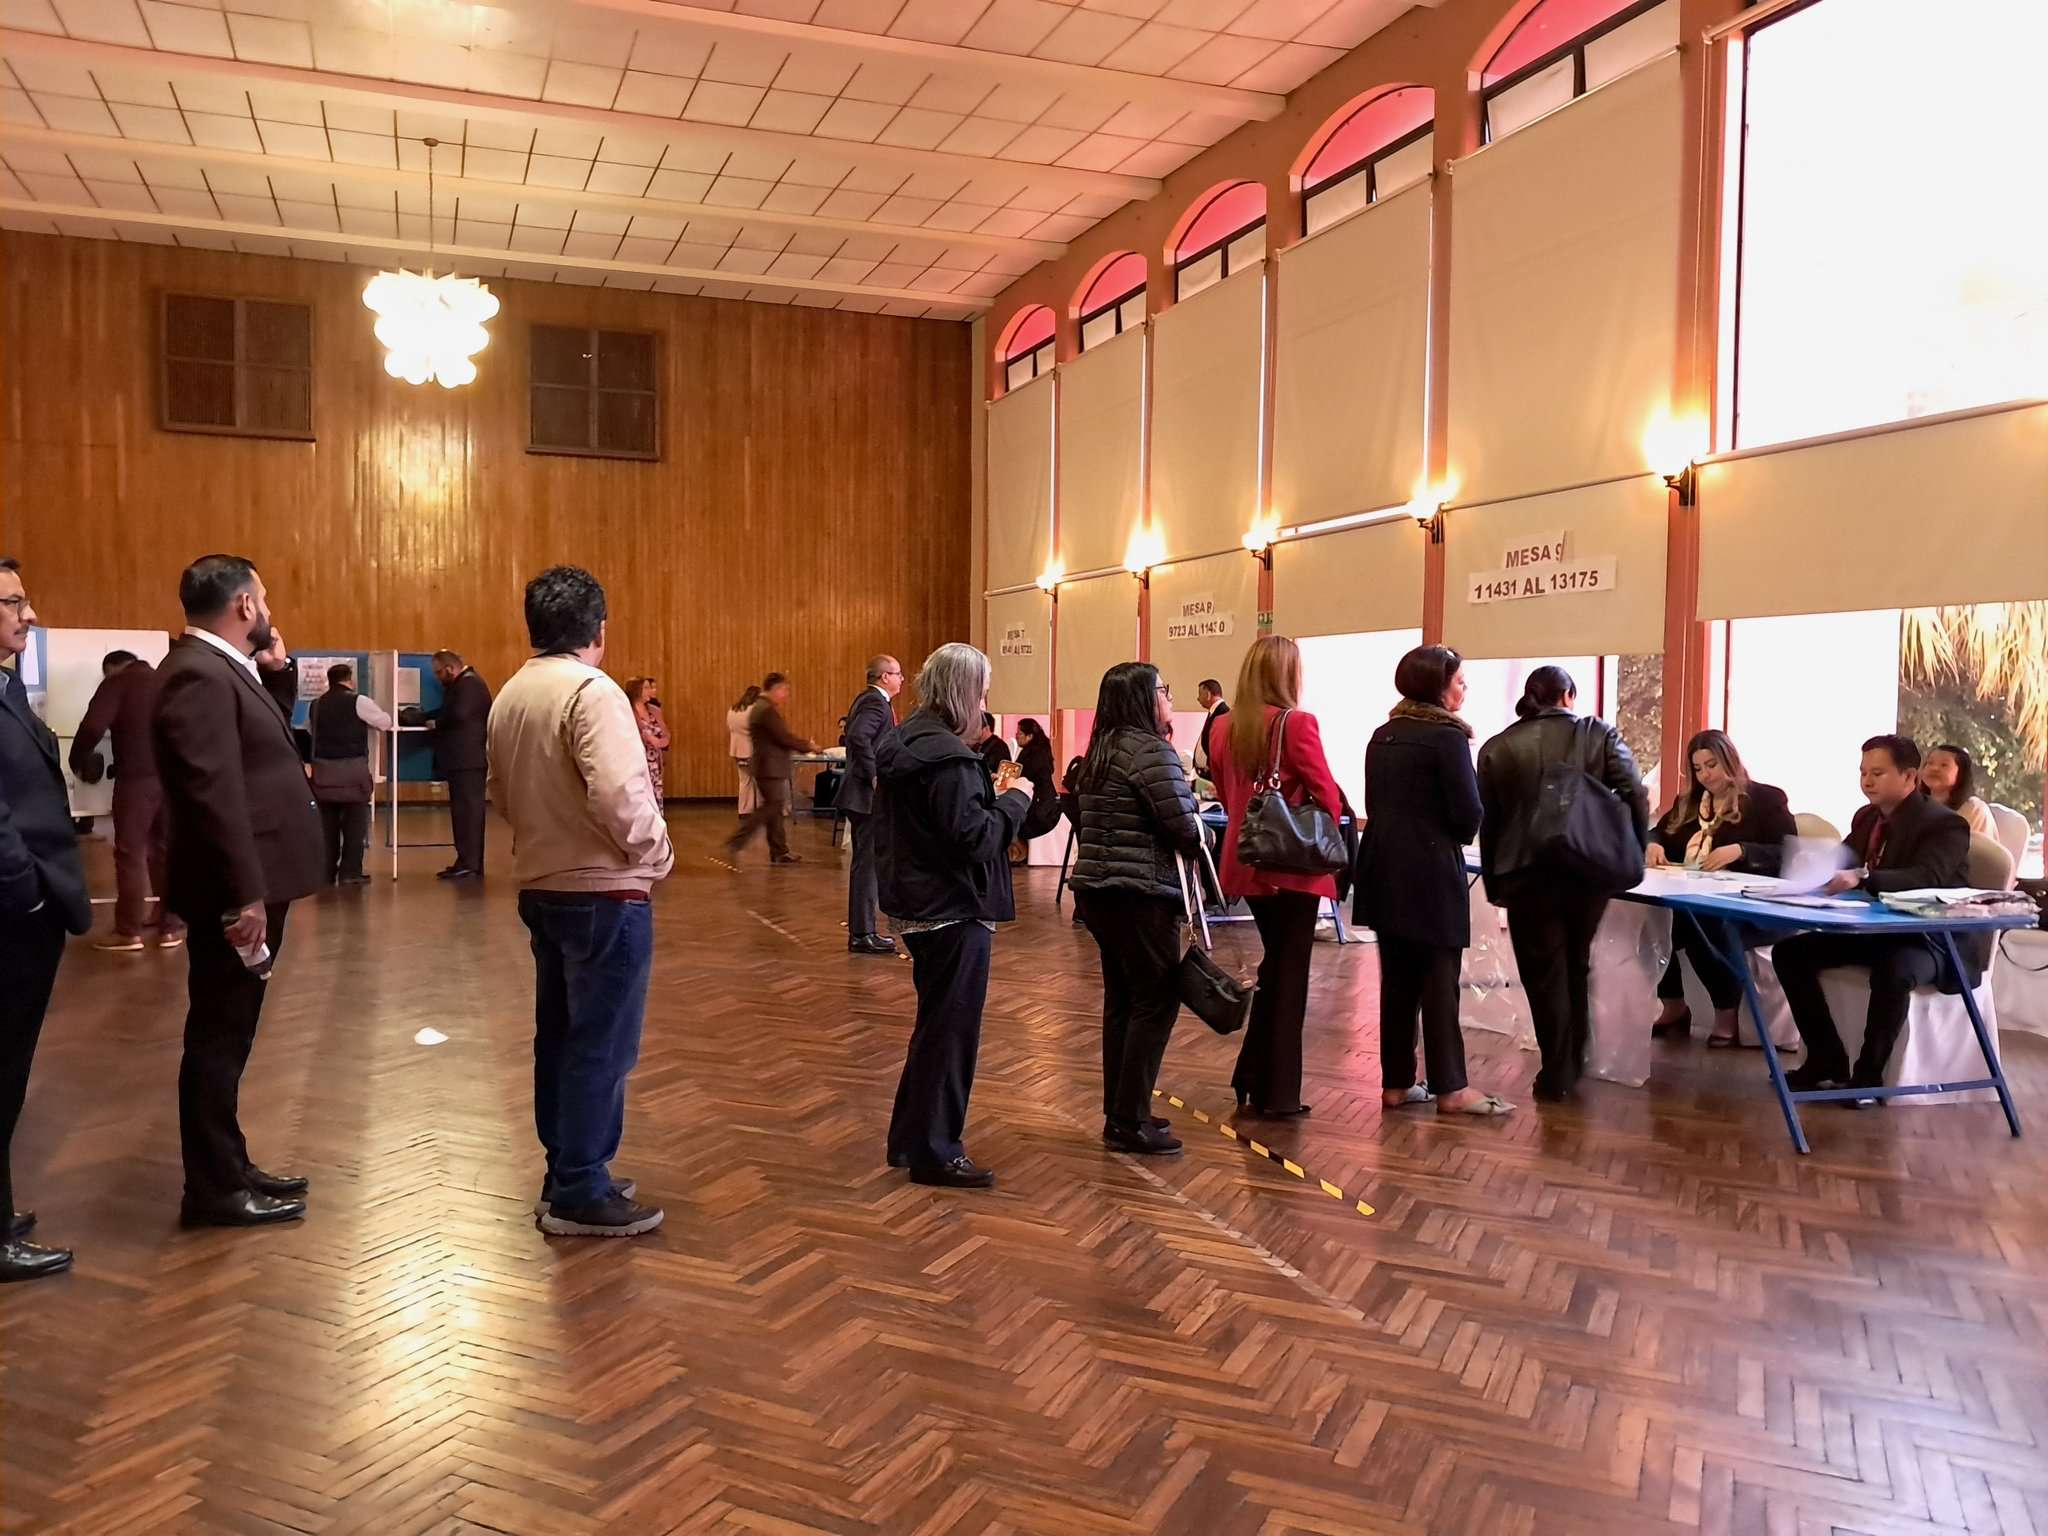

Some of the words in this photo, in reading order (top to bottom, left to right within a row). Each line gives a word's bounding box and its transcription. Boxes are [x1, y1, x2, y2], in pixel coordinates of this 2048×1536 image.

[1505, 545, 1551, 568] MESA
[1474, 580, 1517, 600] 11431
[1523, 577, 1545, 596] AL
[1550, 570, 1599, 590] 13175
[1182, 602, 1205, 616] MESA
[1168, 625, 1187, 637] 9723
[1188, 624, 1199, 637] AL
